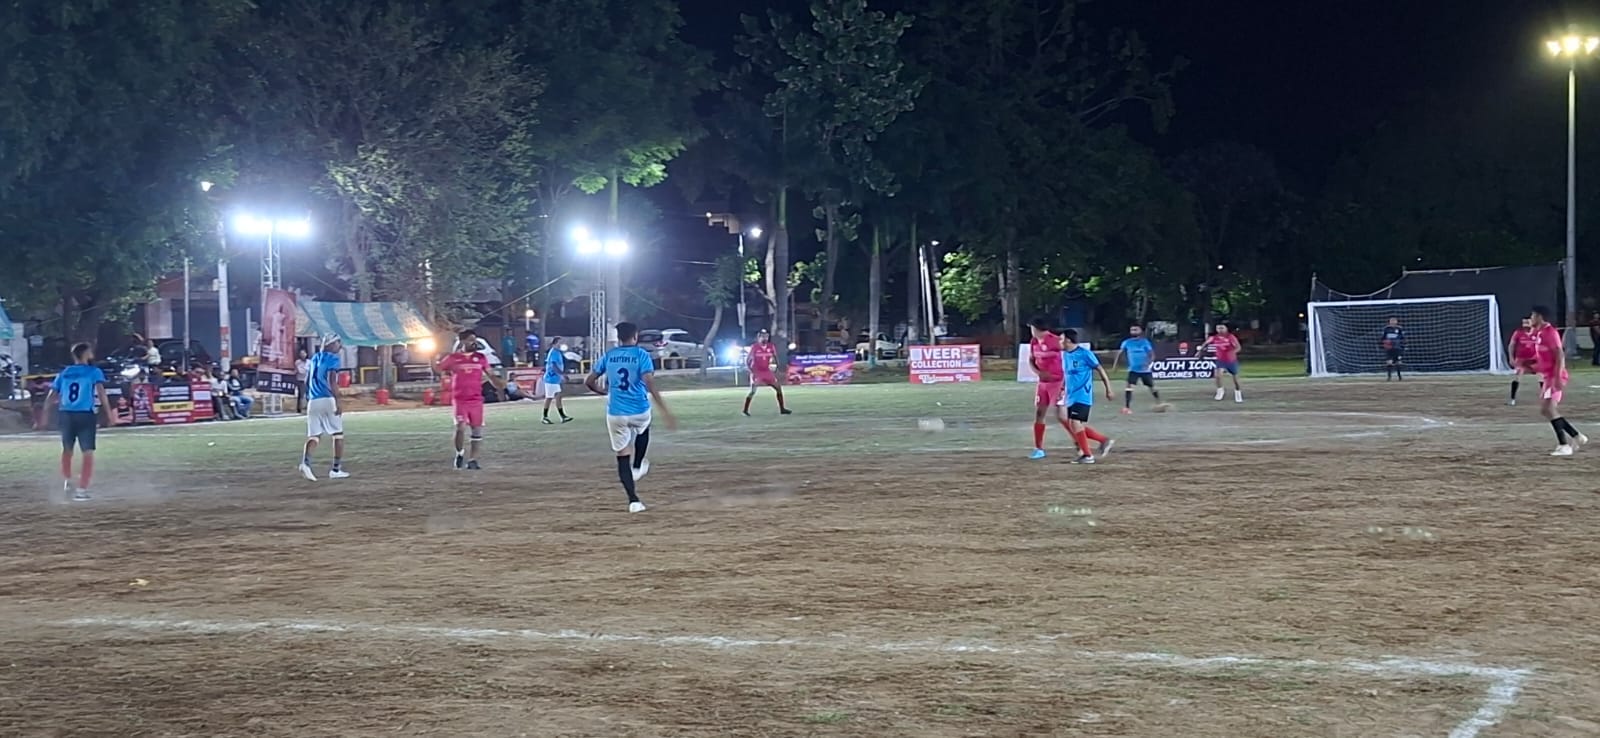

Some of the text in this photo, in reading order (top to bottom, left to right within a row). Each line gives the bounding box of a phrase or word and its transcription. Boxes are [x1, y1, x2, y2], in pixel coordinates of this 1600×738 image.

[923, 348, 961, 360] VEER
[911, 360, 962, 369] COLLECTION
[617, 367, 630, 391] 3
[1151, 371, 1193, 379] WELCOMES
[68, 382, 80, 403] 8
